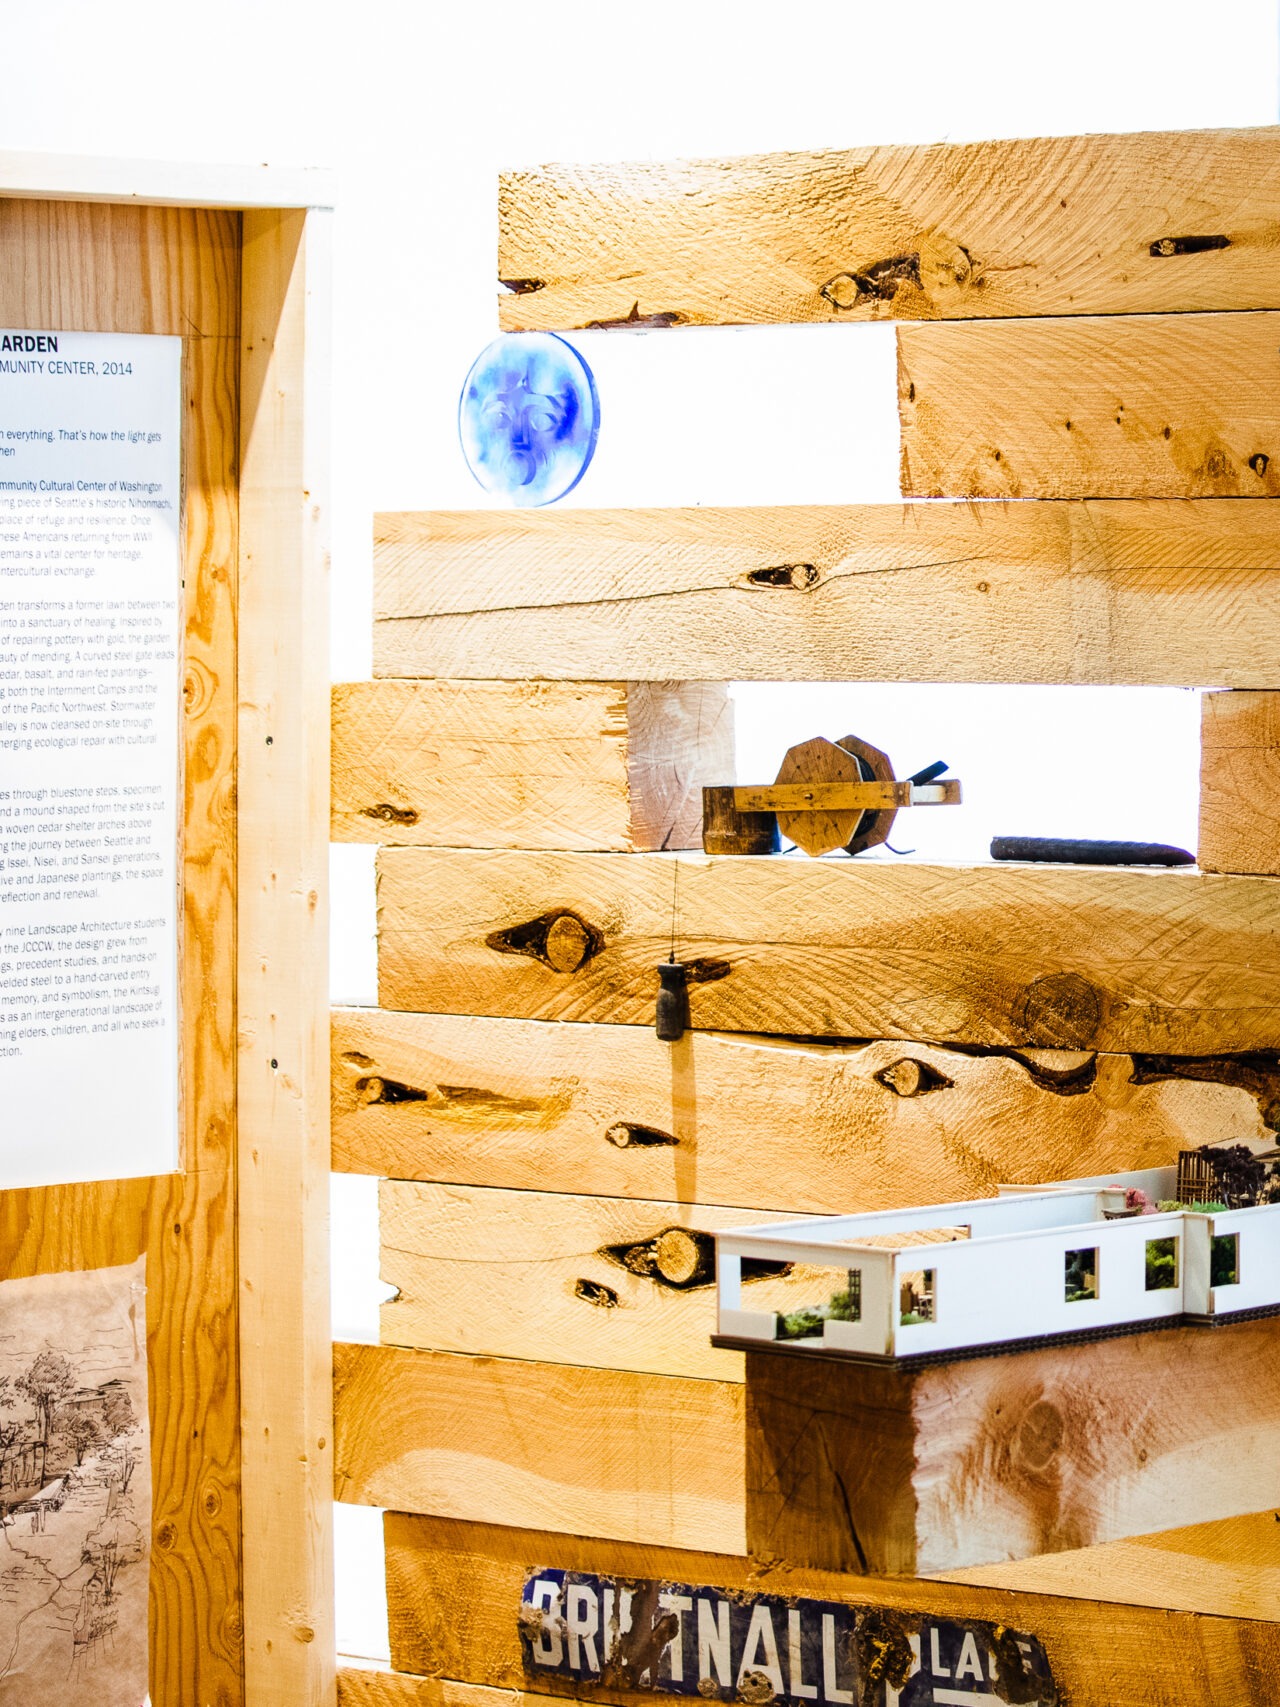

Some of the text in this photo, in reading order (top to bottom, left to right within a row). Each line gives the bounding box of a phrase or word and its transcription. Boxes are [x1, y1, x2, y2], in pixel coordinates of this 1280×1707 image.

[0, 335, 58, 352] ARDEN
[48, 362, 98, 375] CENTER,
[103, 362, 132, 375] 2014
[7, 430, 161, 443] everything. That's how the light gets
[39, 480, 74, 491] Cultural
[77, 481, 106, 491] Center
[119, 481, 162, 493] Washington
[8, 686, 28, 696] both
[31, 686, 44, 696] the
[48, 685, 95, 695] Internment
[98, 684, 126, 696] Camps
[128, 684, 142, 694] and
[14, 703, 28, 713] the
[31, 702, 59, 712] Pacific
[111, 701, 155, 711] Stormwater
[34, 734, 157, 749] ecological repair with cultural
[13, 788, 48, 801] through
[51, 788, 93, 798] bluestone
[123, 785, 161, 796] specimen
[23, 806, 54, 815] mound
[57, 805, 89, 817] shaped
[92, 803, 111, 813] from
[114, 803, 127, 812] the
[6, 819, 151, 834] woven cedar shelter arches above
[12, 835, 151, 852] the journey between Seattle and
[62, 855, 78, 865] and
[81, 854, 110, 865] Sansei
[16, 874, 33, 885] and
[36, 873, 79, 884] Japanese
[126, 870, 139, 879] the
[142, 868, 163, 880] space
[43, 890, 60, 900] and
[6, 918, 166, 936] nine Landscape Architecture students
[4, 944, 18, 953] the
[58, 940, 72, 950] the
[75, 938, 104, 951] design
[107, 939, 126, 950] grew
[129, 936, 147, 945] from
[17, 959, 61, 971] precedent
[102, 954, 118, 964] and
[31, 975, 52, 986] steel
[131, 969, 150, 980] entry
[42, 992, 58, 1002] and
[114, 986, 127, 996] the
[35, 1005, 110, 1021] intergenerational
[112, 1002, 153, 1014] landscape
[92, 1022, 108, 1033] and
[124, 1019, 140, 1029] who
[142, 1019, 159, 1028] seek
